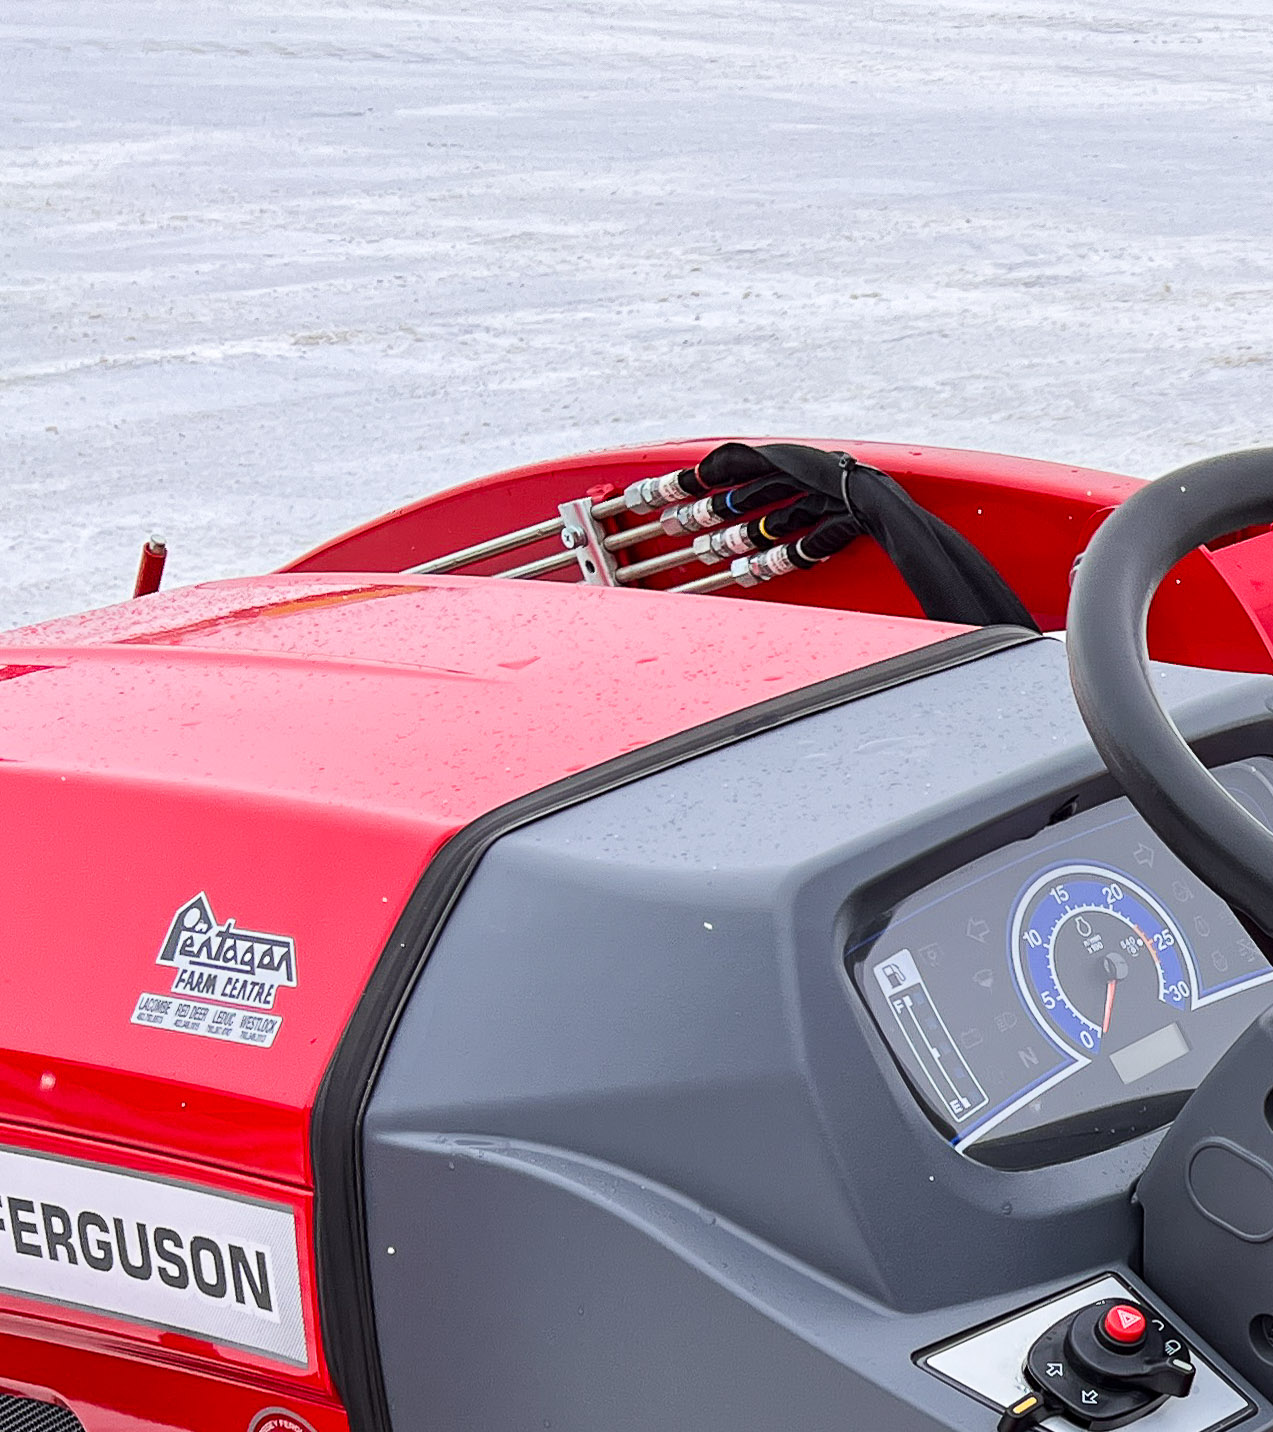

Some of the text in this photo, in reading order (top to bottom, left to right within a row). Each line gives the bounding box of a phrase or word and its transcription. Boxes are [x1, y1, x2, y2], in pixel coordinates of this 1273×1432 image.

[1049, 884, 1070, 905] 15
[1102, 883, 1124, 904] 20
[160, 896, 294, 982] Pentagon
[1023, 929, 1043, 949] 10
[1153, 929, 1175, 951] 25
[175, 969, 274, 1005] FARM CENTRE
[1169, 980, 1190, 1002] 30
[892, 999, 904, 1014] F
[1040, 991, 1056, 1010] 5
[1080, 1030, 1095, 1049] 0
[950, 1099, 963, 1114] E
